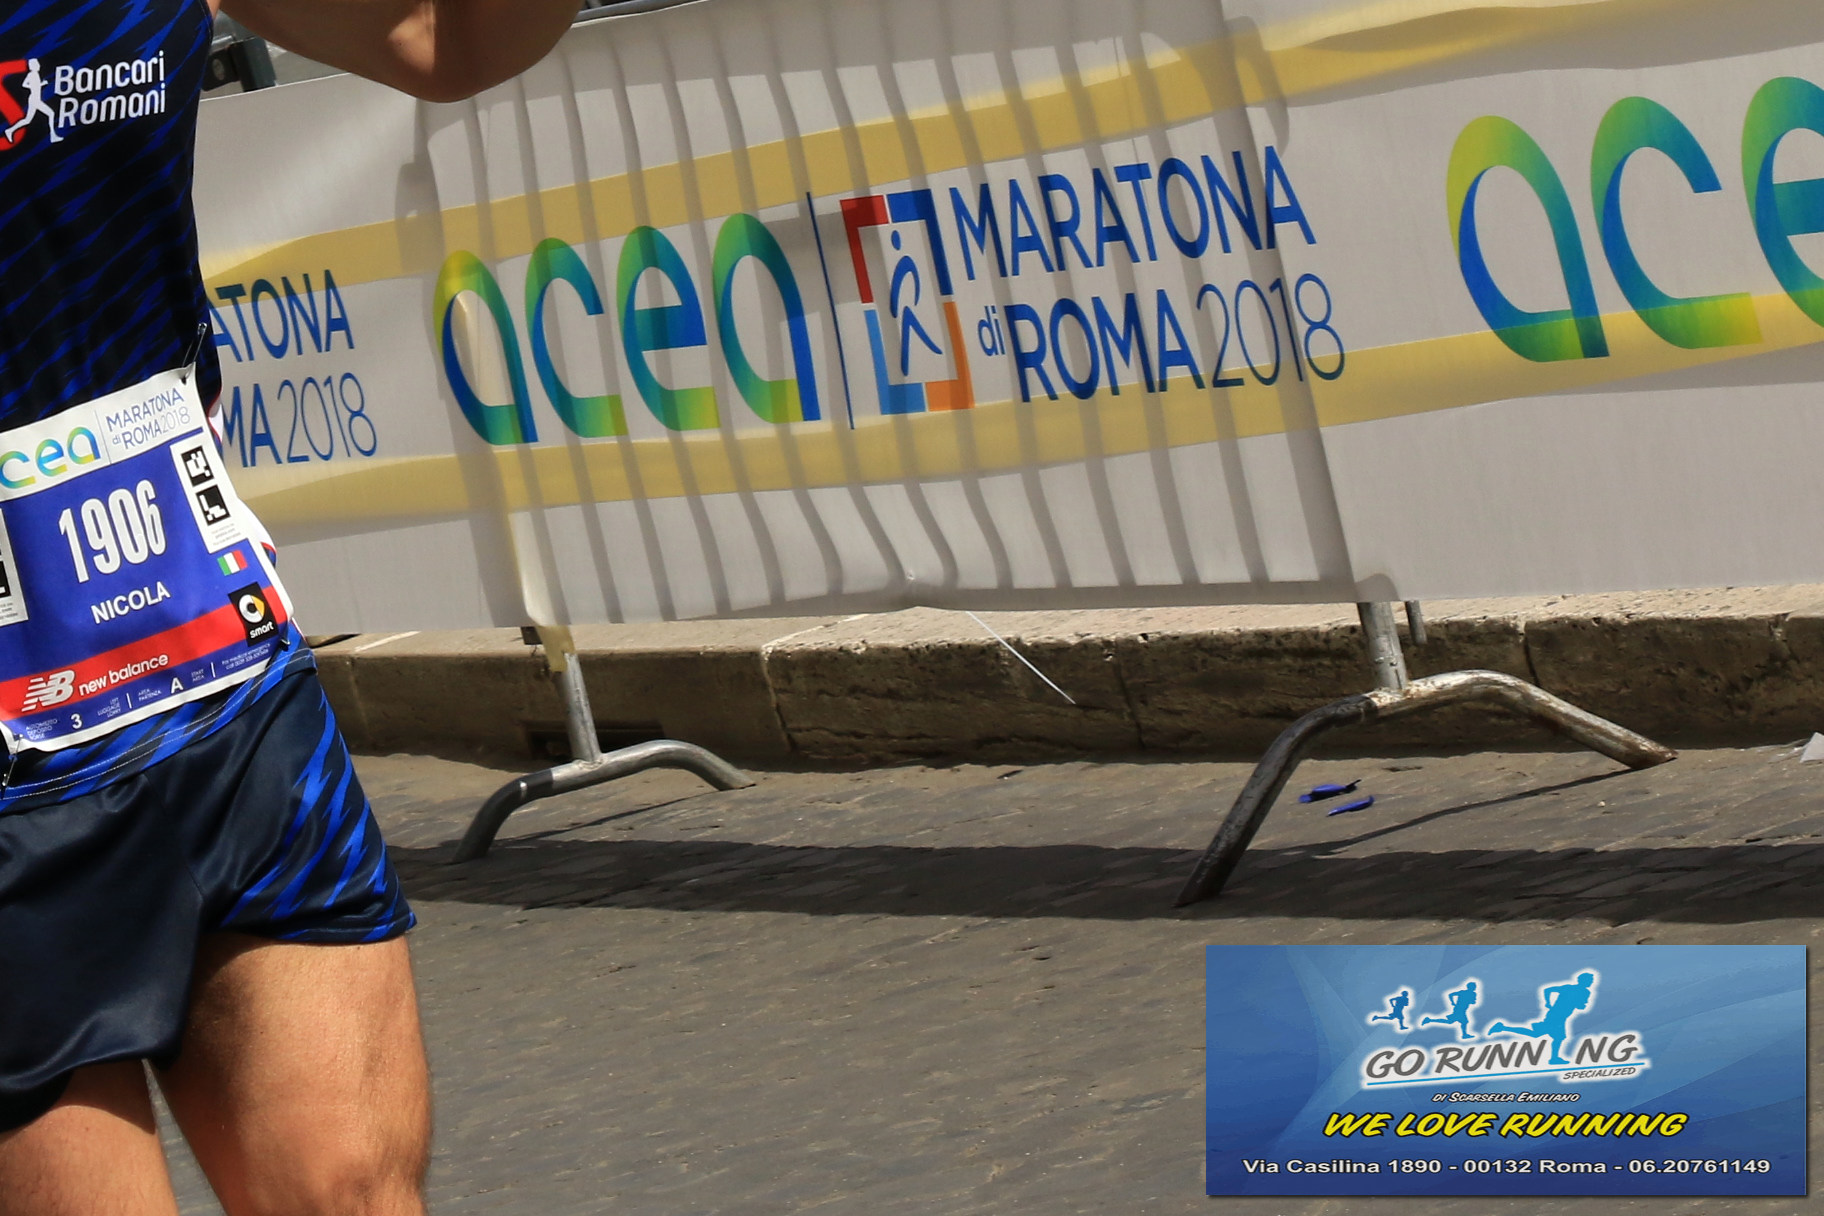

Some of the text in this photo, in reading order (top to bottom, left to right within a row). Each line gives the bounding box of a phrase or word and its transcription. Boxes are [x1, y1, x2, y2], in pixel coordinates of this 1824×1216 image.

[54, 50, 165, 96] Bancari
[58, 83, 166, 129] Romani
[949, 145, 1317, 281] MARATONA
[433, 213, 821, 446] acea
[977, 305, 1007, 357] di
[106, 387, 185, 433] MARATONA
[58, 479, 167, 584] 1906
[90, 581, 171, 624] NICOLA
[249, 621, 275, 639] smart
[78, 675, 108, 697] new
[109, 653, 169, 685] balance
[170, 678, 184, 694] A
[70, 713, 82, 729] 3
